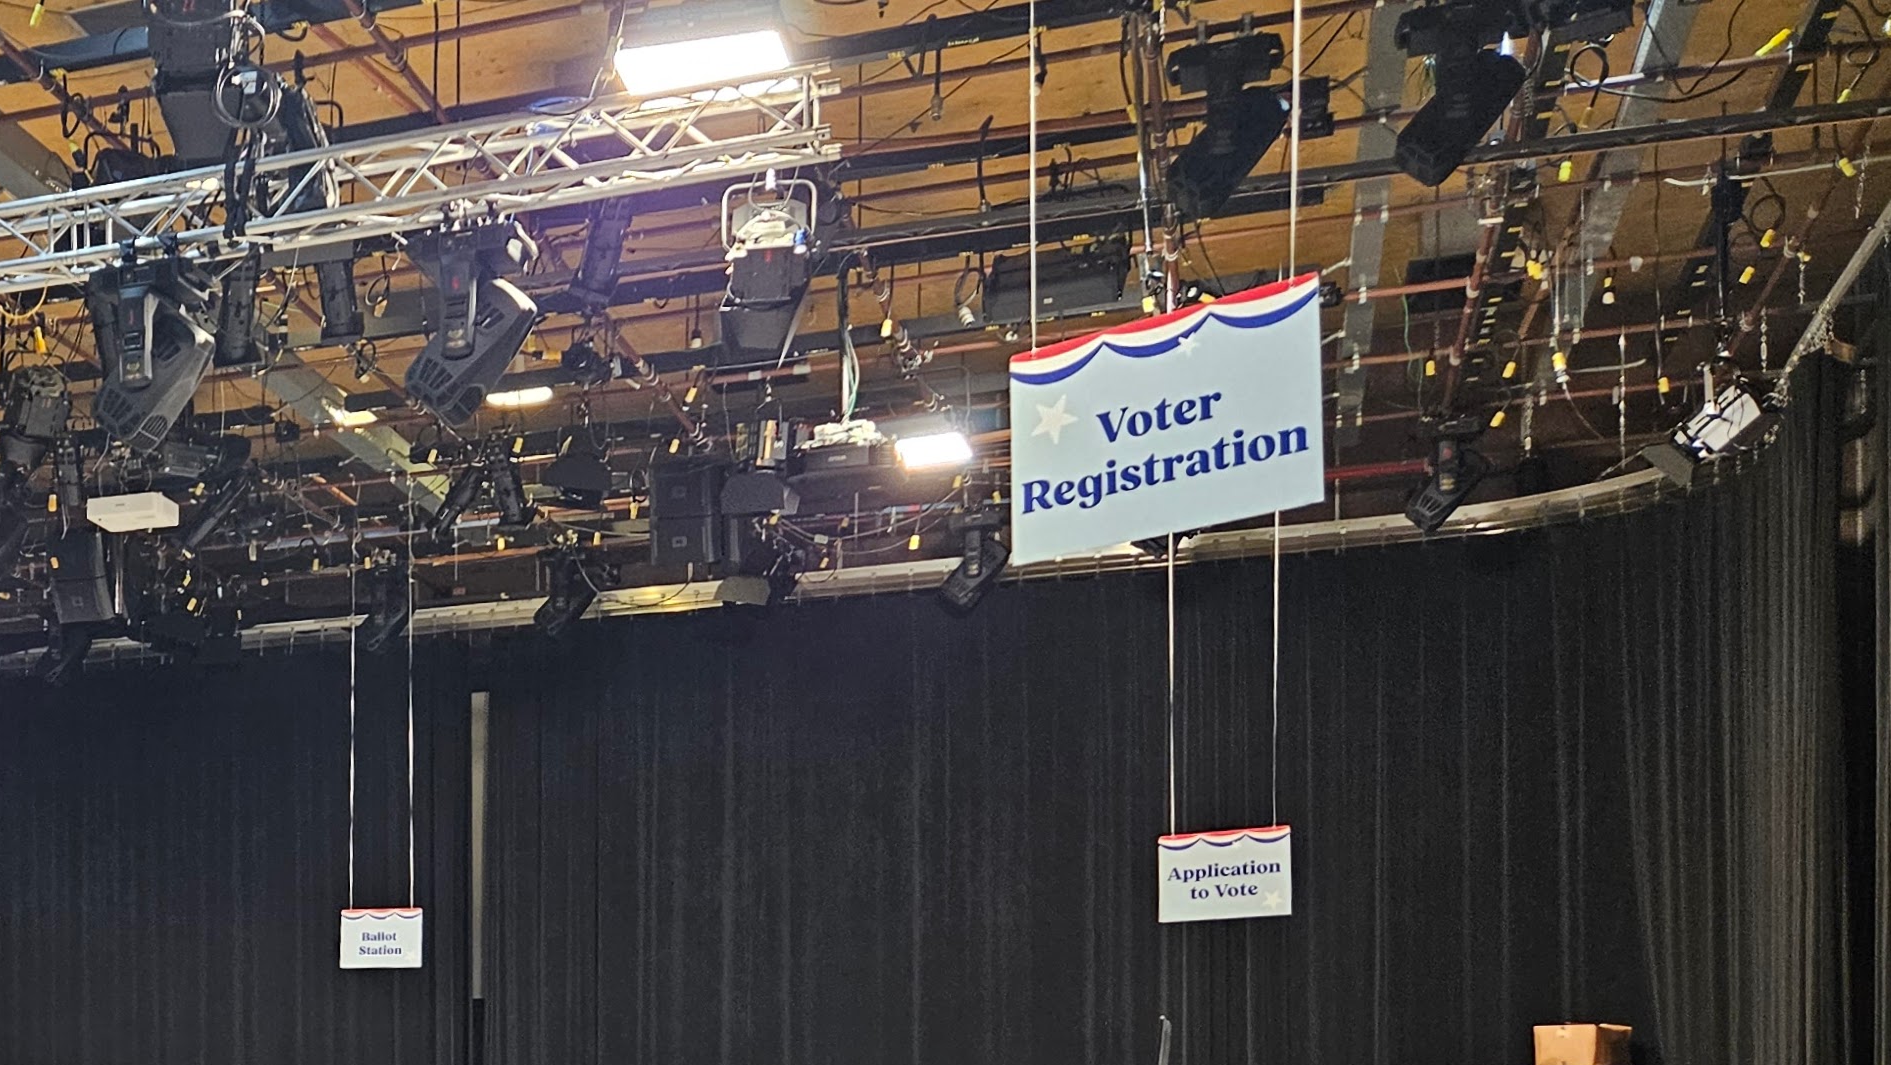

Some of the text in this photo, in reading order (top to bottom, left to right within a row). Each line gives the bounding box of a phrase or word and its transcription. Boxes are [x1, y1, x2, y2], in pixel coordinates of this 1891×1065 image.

[1096, 391, 1222, 443] Voter
[1021, 425, 1309, 514] Registration
[1167, 860, 1281, 883] Application
[1190, 884, 1258, 900] to Vote
[361, 931, 397, 942] Ballot
[358, 945, 402, 955] Station
